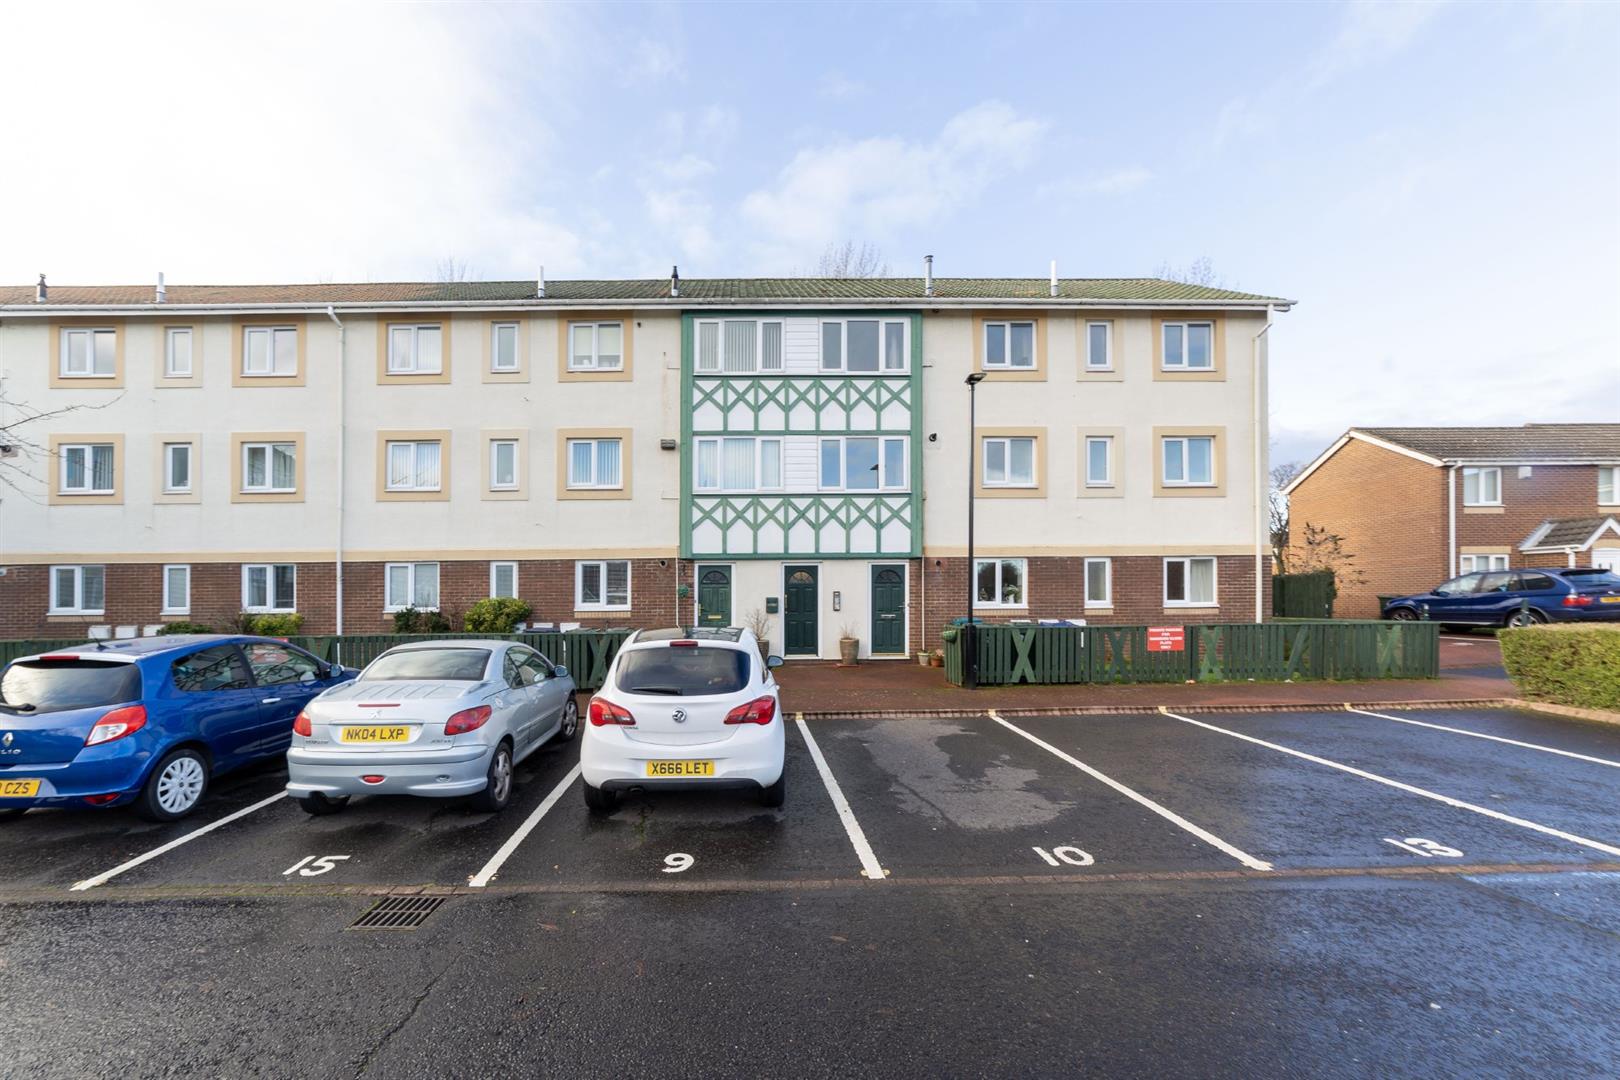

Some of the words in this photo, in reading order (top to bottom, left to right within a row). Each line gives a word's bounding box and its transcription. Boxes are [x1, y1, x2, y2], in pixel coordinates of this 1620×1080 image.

[346, 728, 376, 740] NK04
[379, 728, 404, 740] LXP
[651, 762, 682, 774] X666
[685, 762, 709, 774] LET
[4, 782, 31, 794] CZS
[1032, 846, 1095, 866] 10
[1383, 837, 1464, 857] 13
[282, 855, 351, 876] 15
[662, 853, 695, 873] 9
